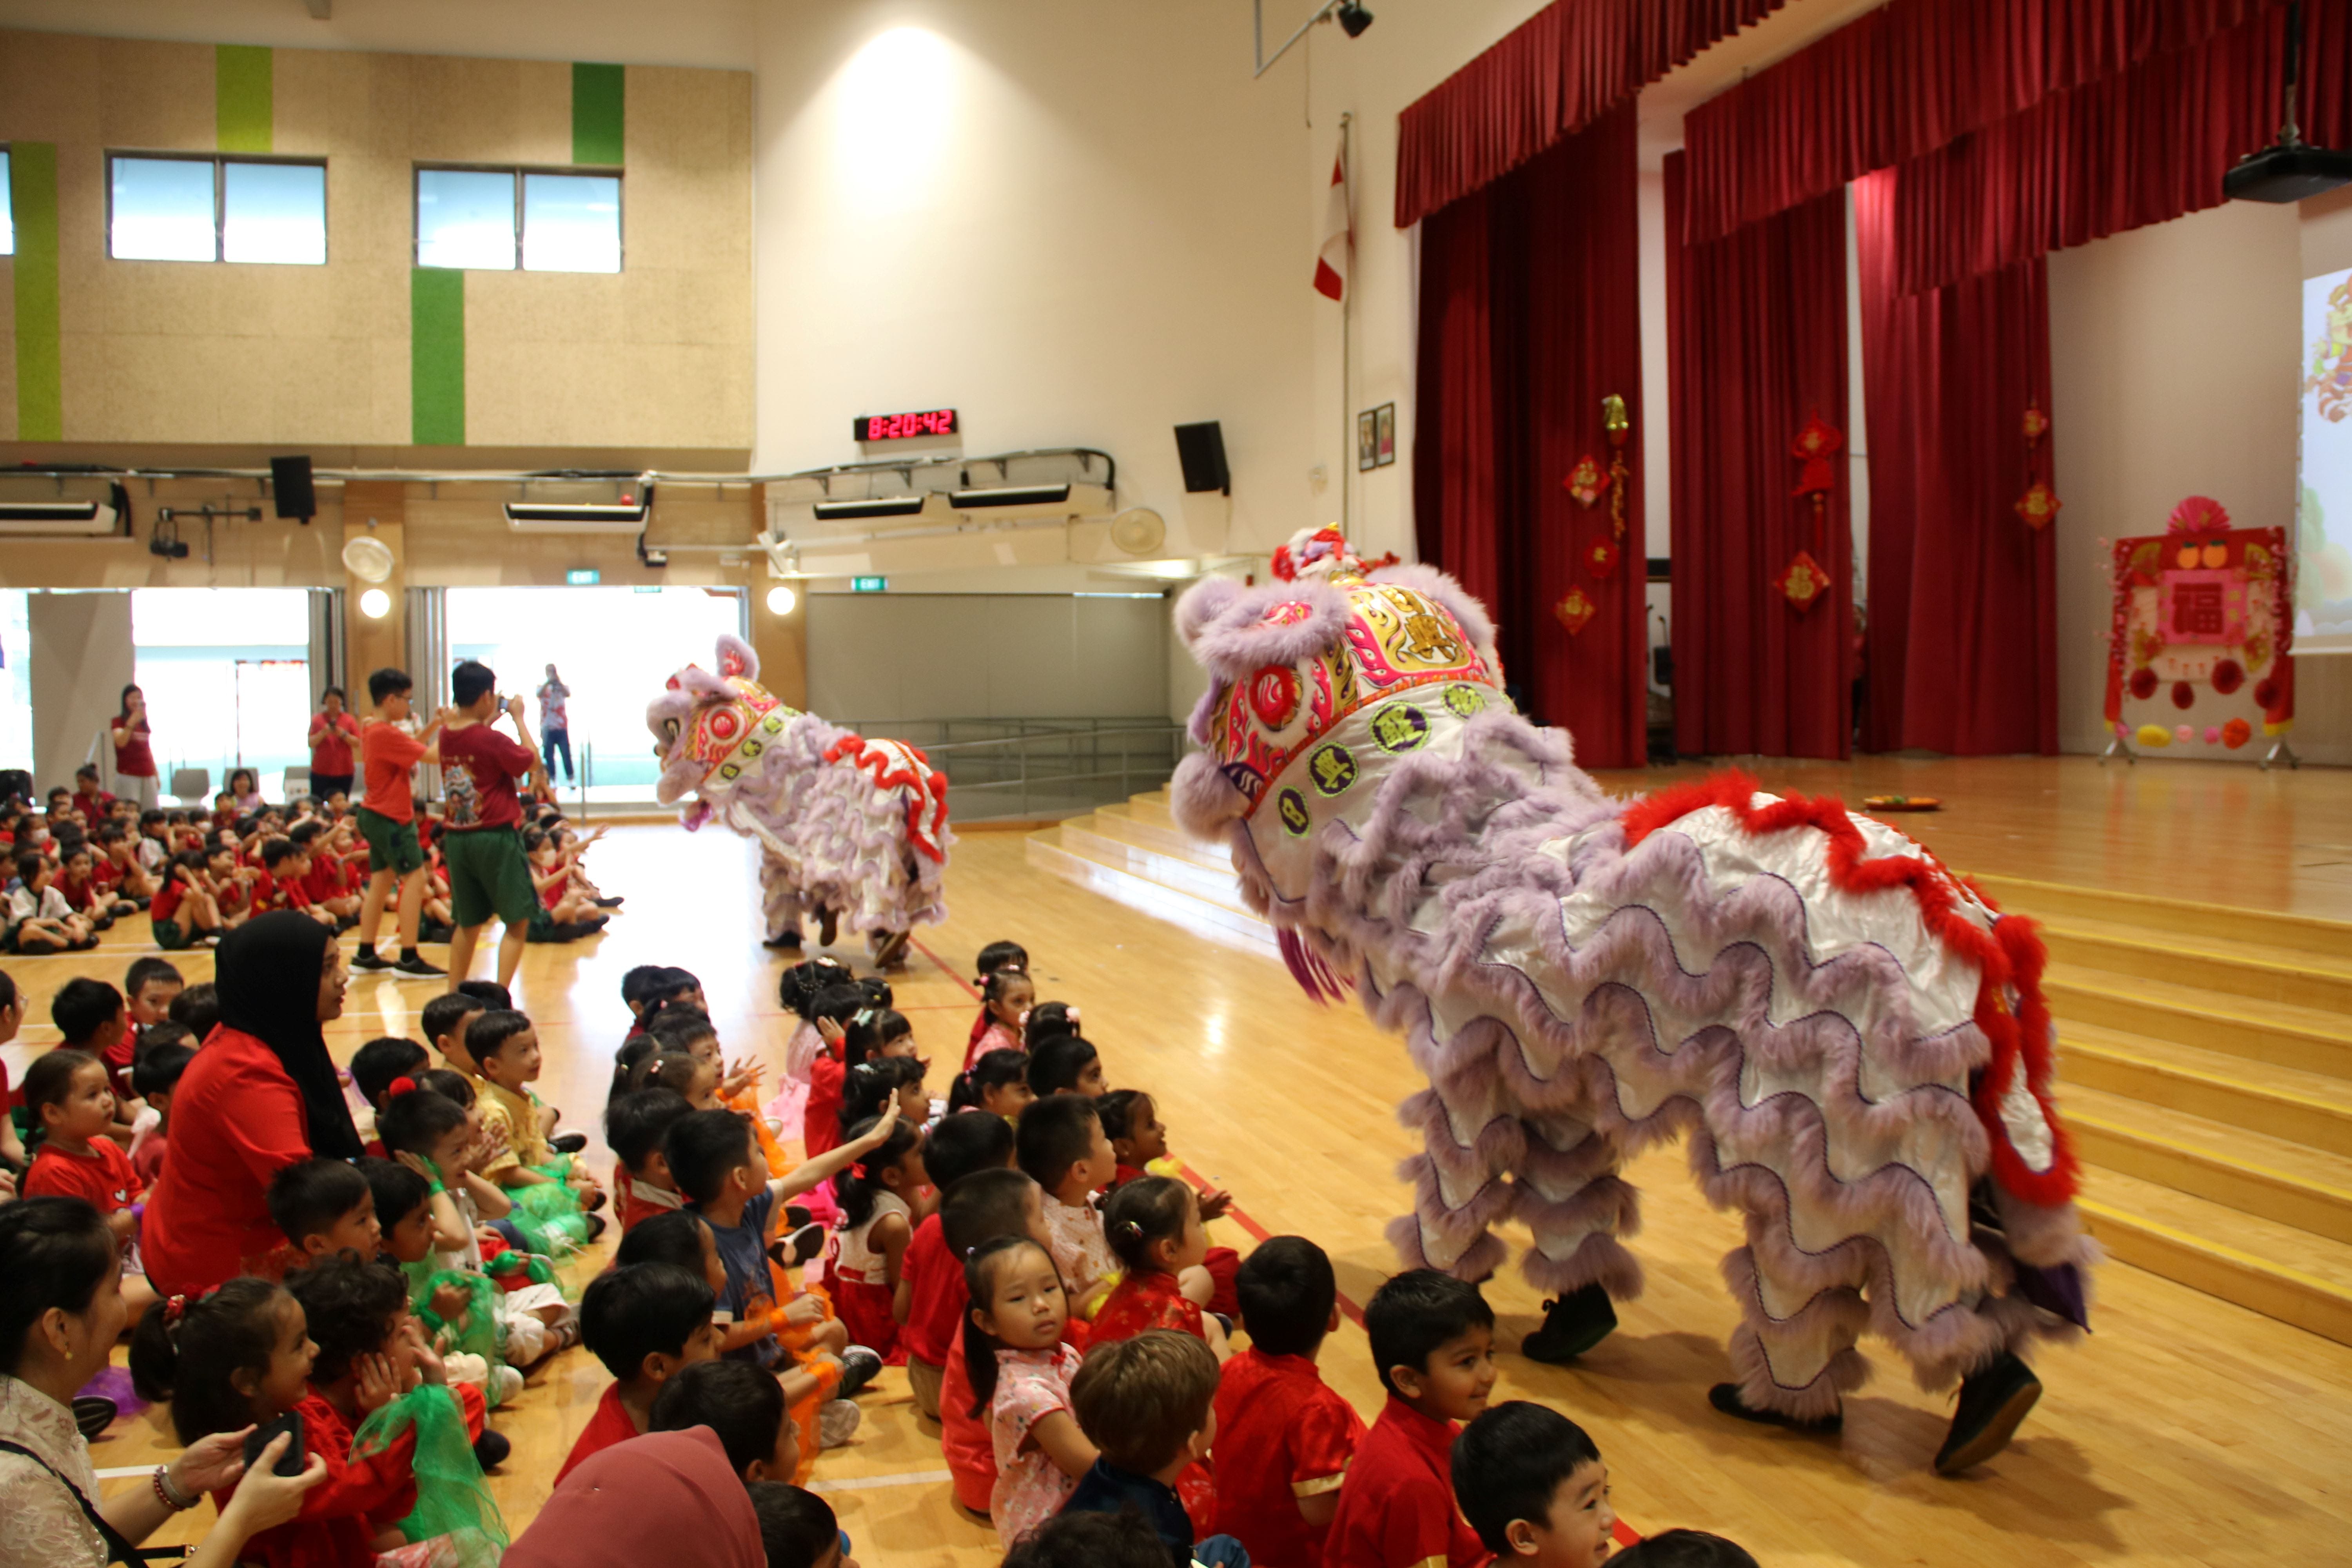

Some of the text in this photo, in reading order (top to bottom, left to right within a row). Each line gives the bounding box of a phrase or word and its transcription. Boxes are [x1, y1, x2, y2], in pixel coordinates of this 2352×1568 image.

[868, 409, 952, 440] 8:20:42
[860, 578, 880, 590] EXIT
[2173, 583, 2223, 634] 福
